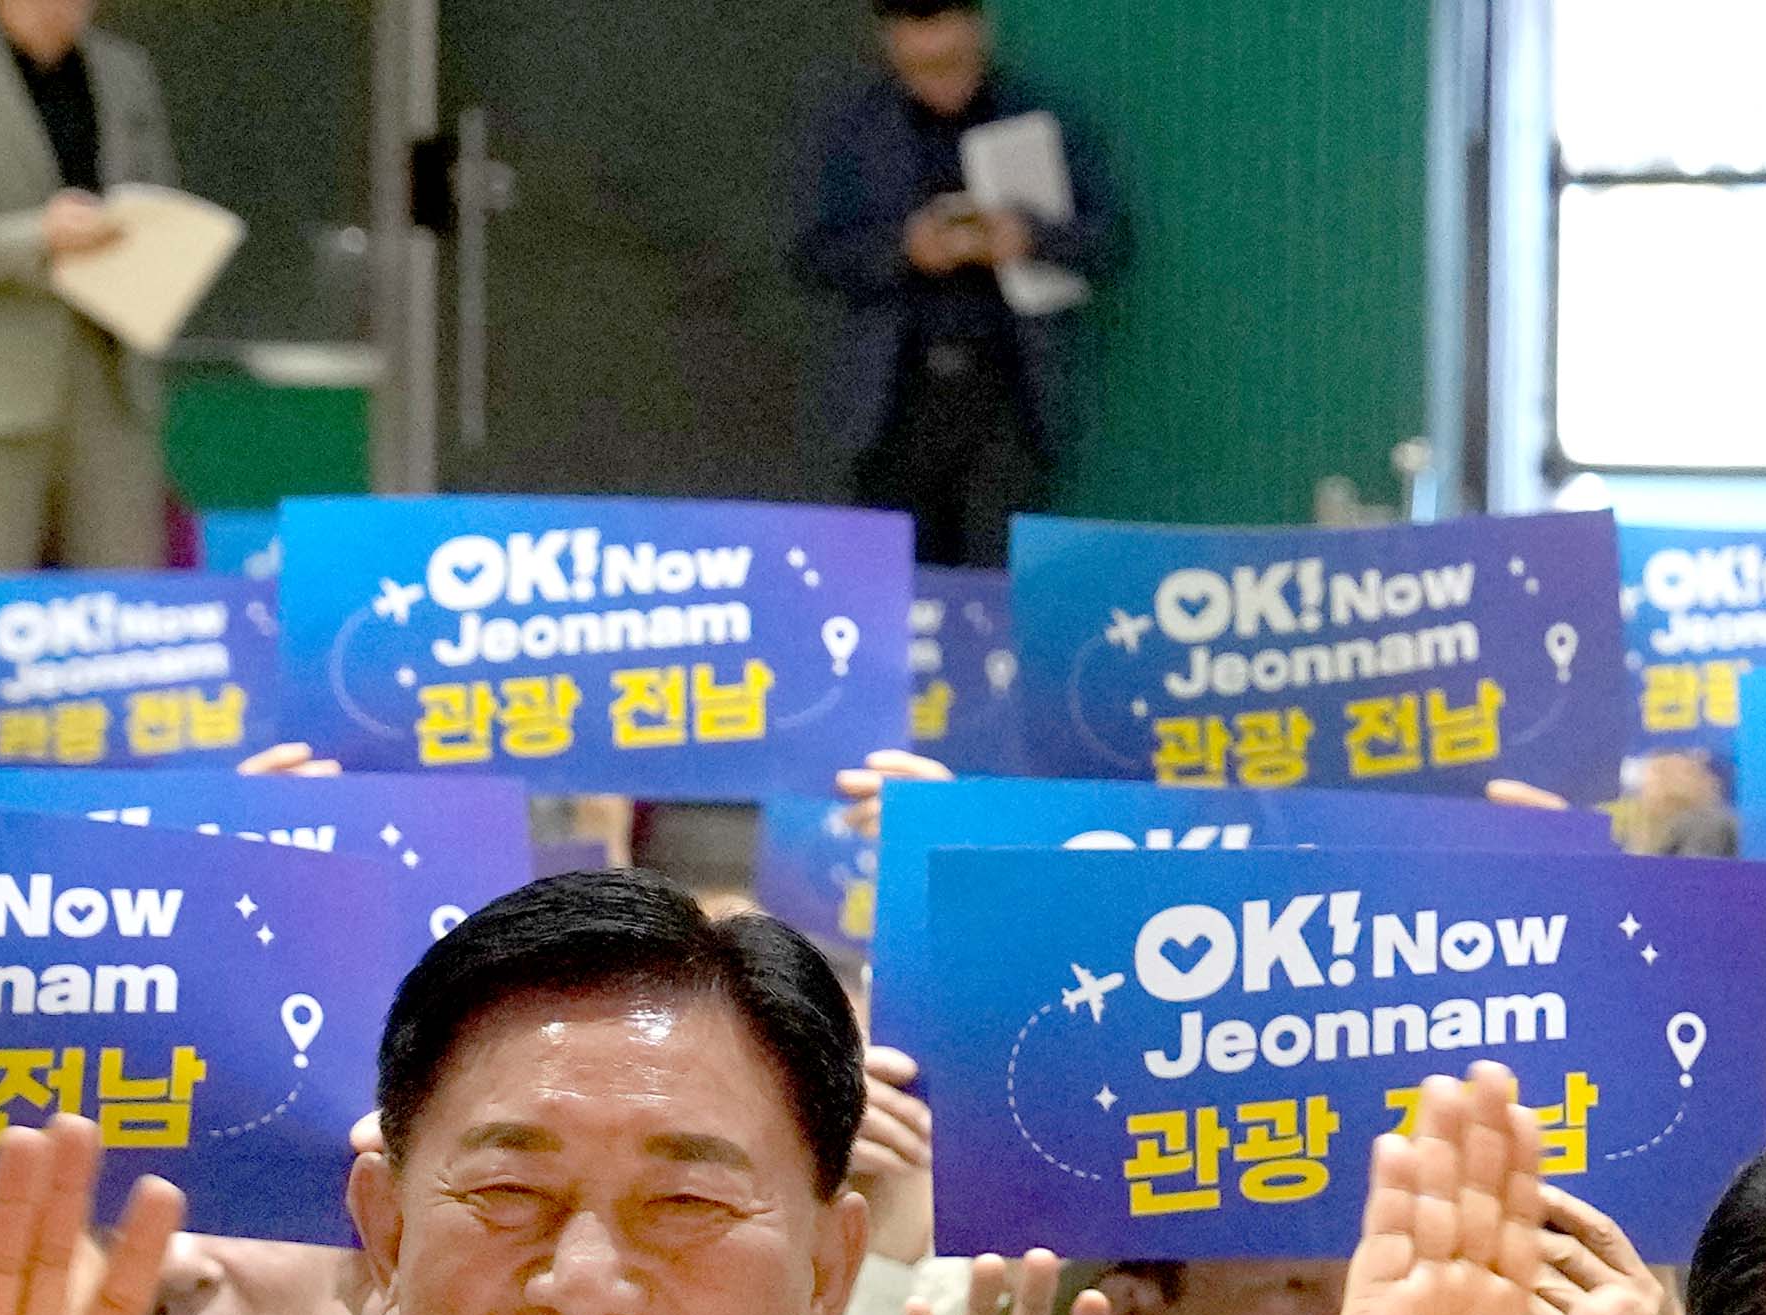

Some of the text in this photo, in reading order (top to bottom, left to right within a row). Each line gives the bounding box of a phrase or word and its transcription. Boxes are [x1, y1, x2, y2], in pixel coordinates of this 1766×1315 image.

[428, 528, 753, 612] OK! Now
[1155, 557, 1476, 643] OK! Now
[1642, 544, 1763, 611] OK!
[434, 601, 752, 668] Jeonnam
[1165, 619, 1479, 699] Jeonnam
[417, 659, 775, 766] 관광 전남
[1153, 679, 1505, 789] 관광 전남
[1134, 891, 1568, 1003] OK! Now
[1143, 992, 1567, 1080] Jeonnam
[1122, 1095, 1341, 1218] 관광
